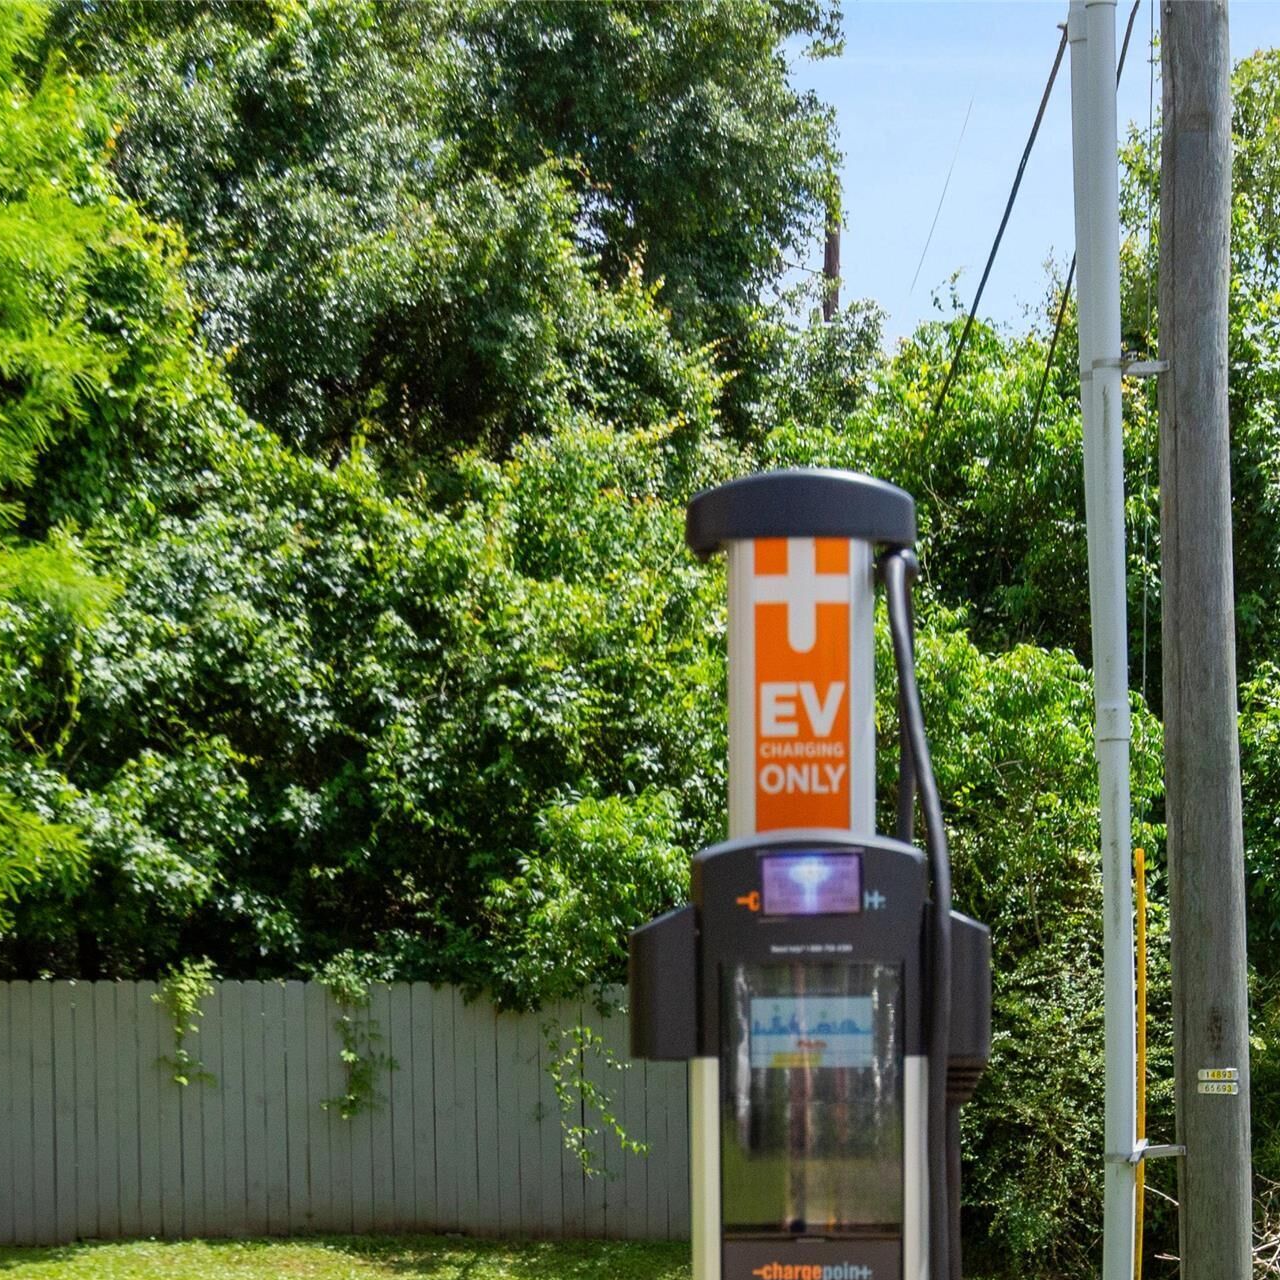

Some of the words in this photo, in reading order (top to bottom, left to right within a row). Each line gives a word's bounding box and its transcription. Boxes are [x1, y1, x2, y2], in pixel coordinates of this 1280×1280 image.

[760, 682, 845, 737] EV
[760, 742, 843, 757] CHARGING
[760, 764, 846, 794] ONLY
